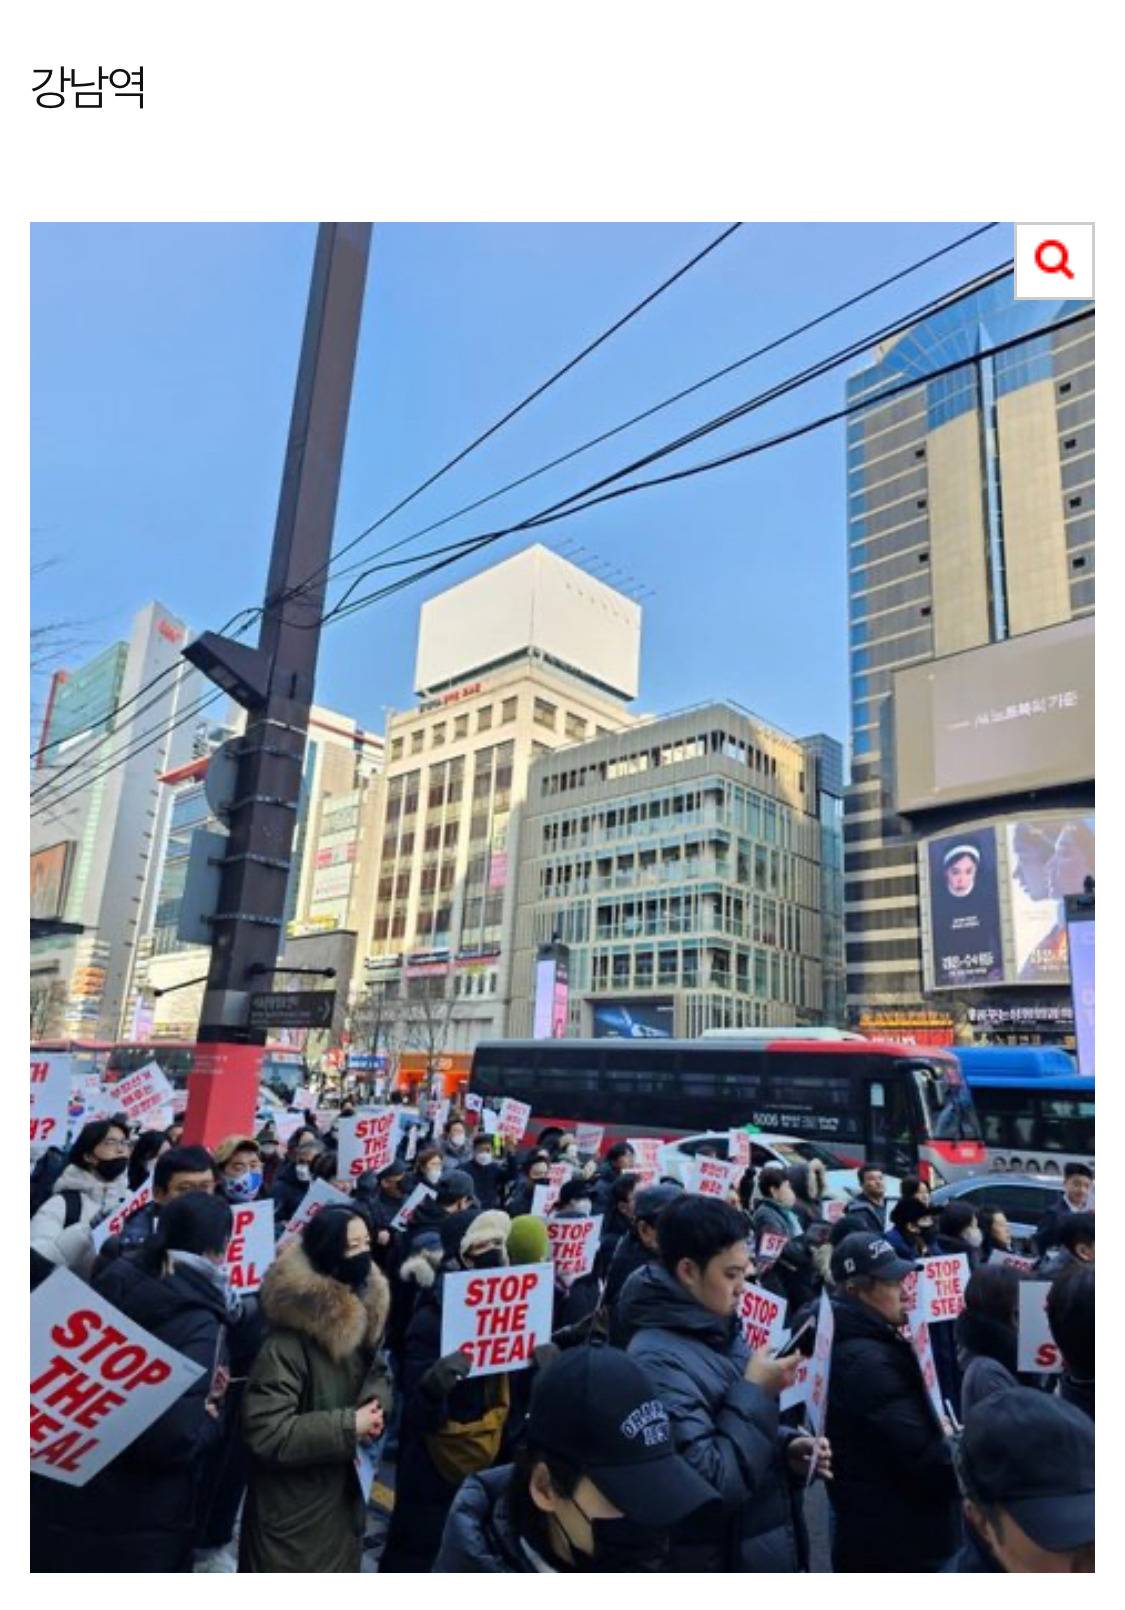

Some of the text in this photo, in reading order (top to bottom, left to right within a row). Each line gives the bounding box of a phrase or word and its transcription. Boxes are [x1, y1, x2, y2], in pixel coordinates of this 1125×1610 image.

[355, 1112, 395, 1138] STOP
[363, 1132, 389, 1155] THE
[547, 1221, 593, 1240] STOP
[553, 1241, 585, 1259] THE
[926, 1259, 962, 1280] STOP
[463, 1272, 539, 1307] STOP
[936, 1279, 962, 1298] THE
[475, 1303, 529, 1337] THE
[742, 1292, 778, 1327] STOP
[51, 1309, 173, 1392] STOP
[30, 1355, 127, 1430] THE
